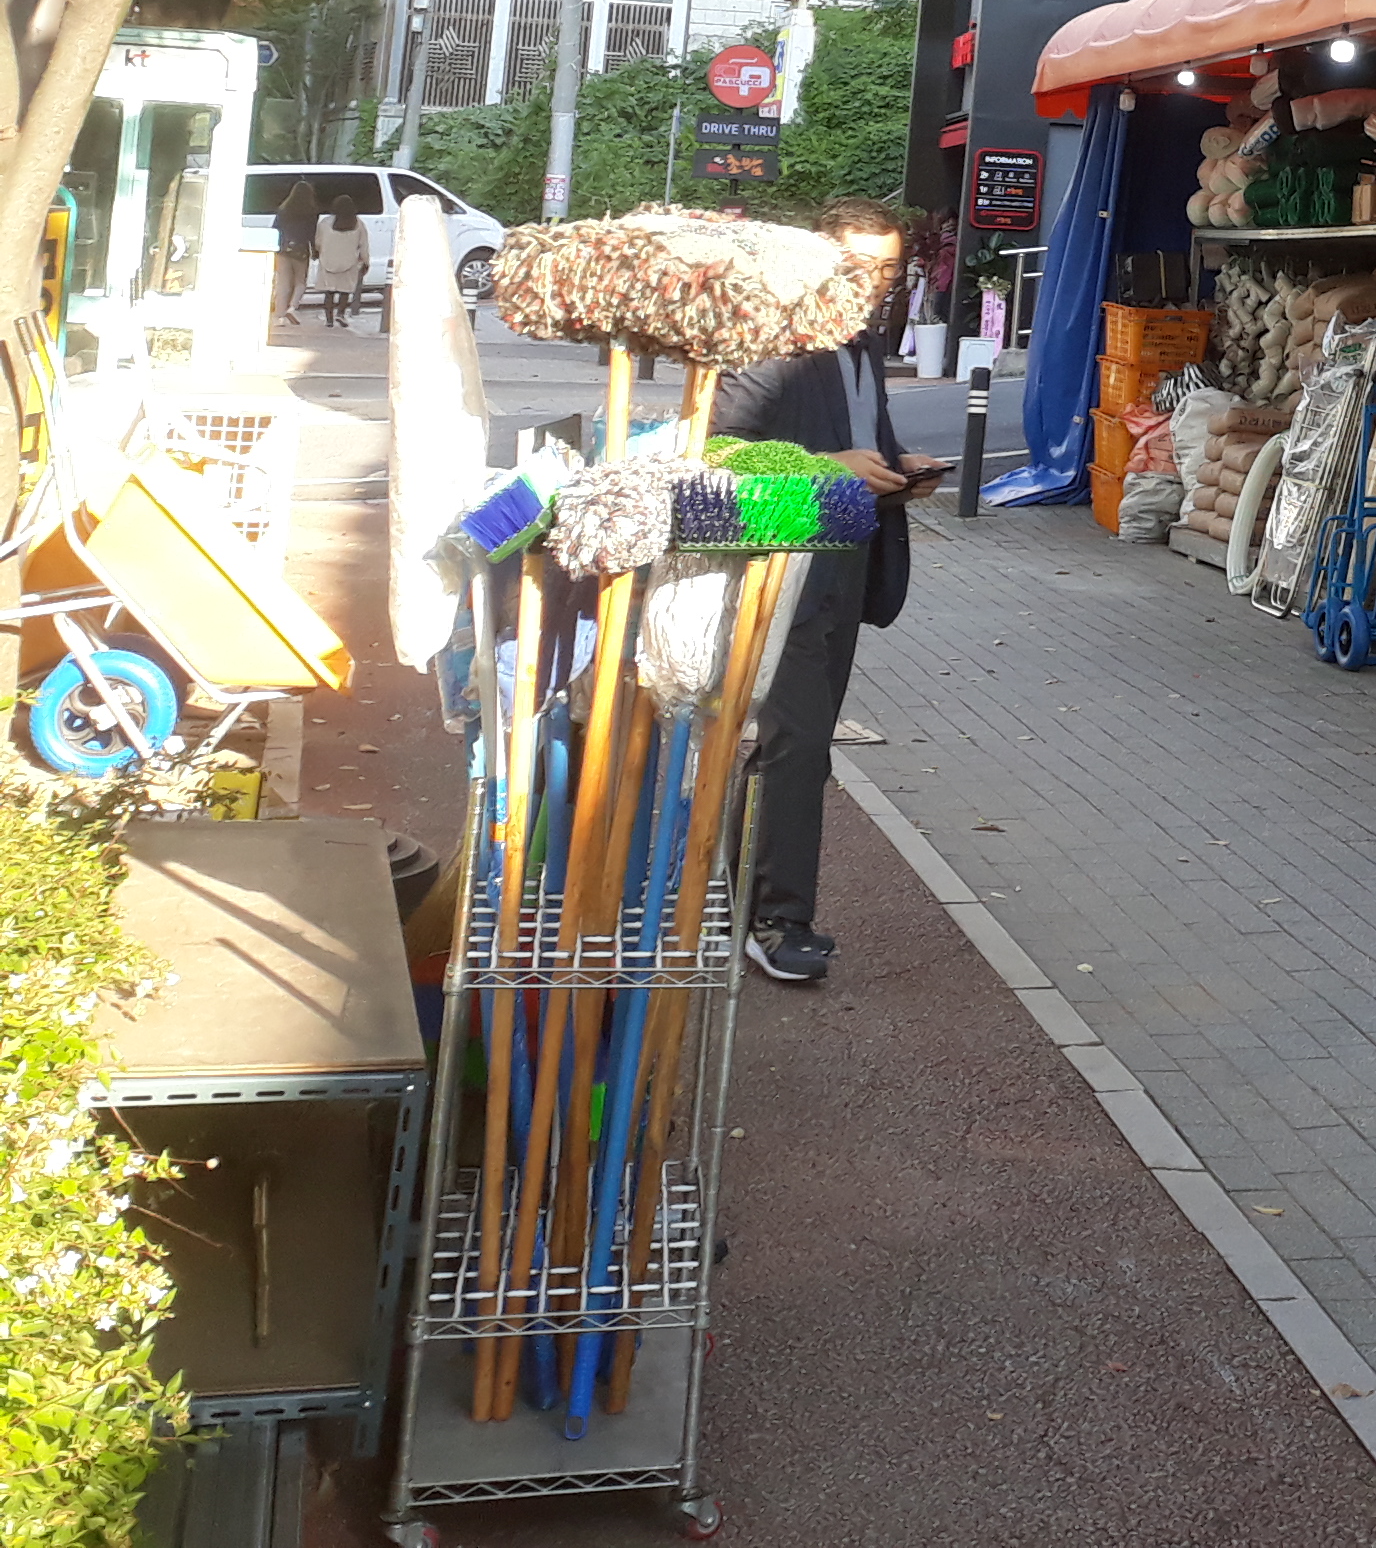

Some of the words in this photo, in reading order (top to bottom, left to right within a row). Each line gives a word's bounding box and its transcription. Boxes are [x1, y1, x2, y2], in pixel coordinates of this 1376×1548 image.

[714, 78, 762, 87] PASCUCCI
[702, 122, 739, 135] DRIVE
[743, 124, 776, 137] THRU
